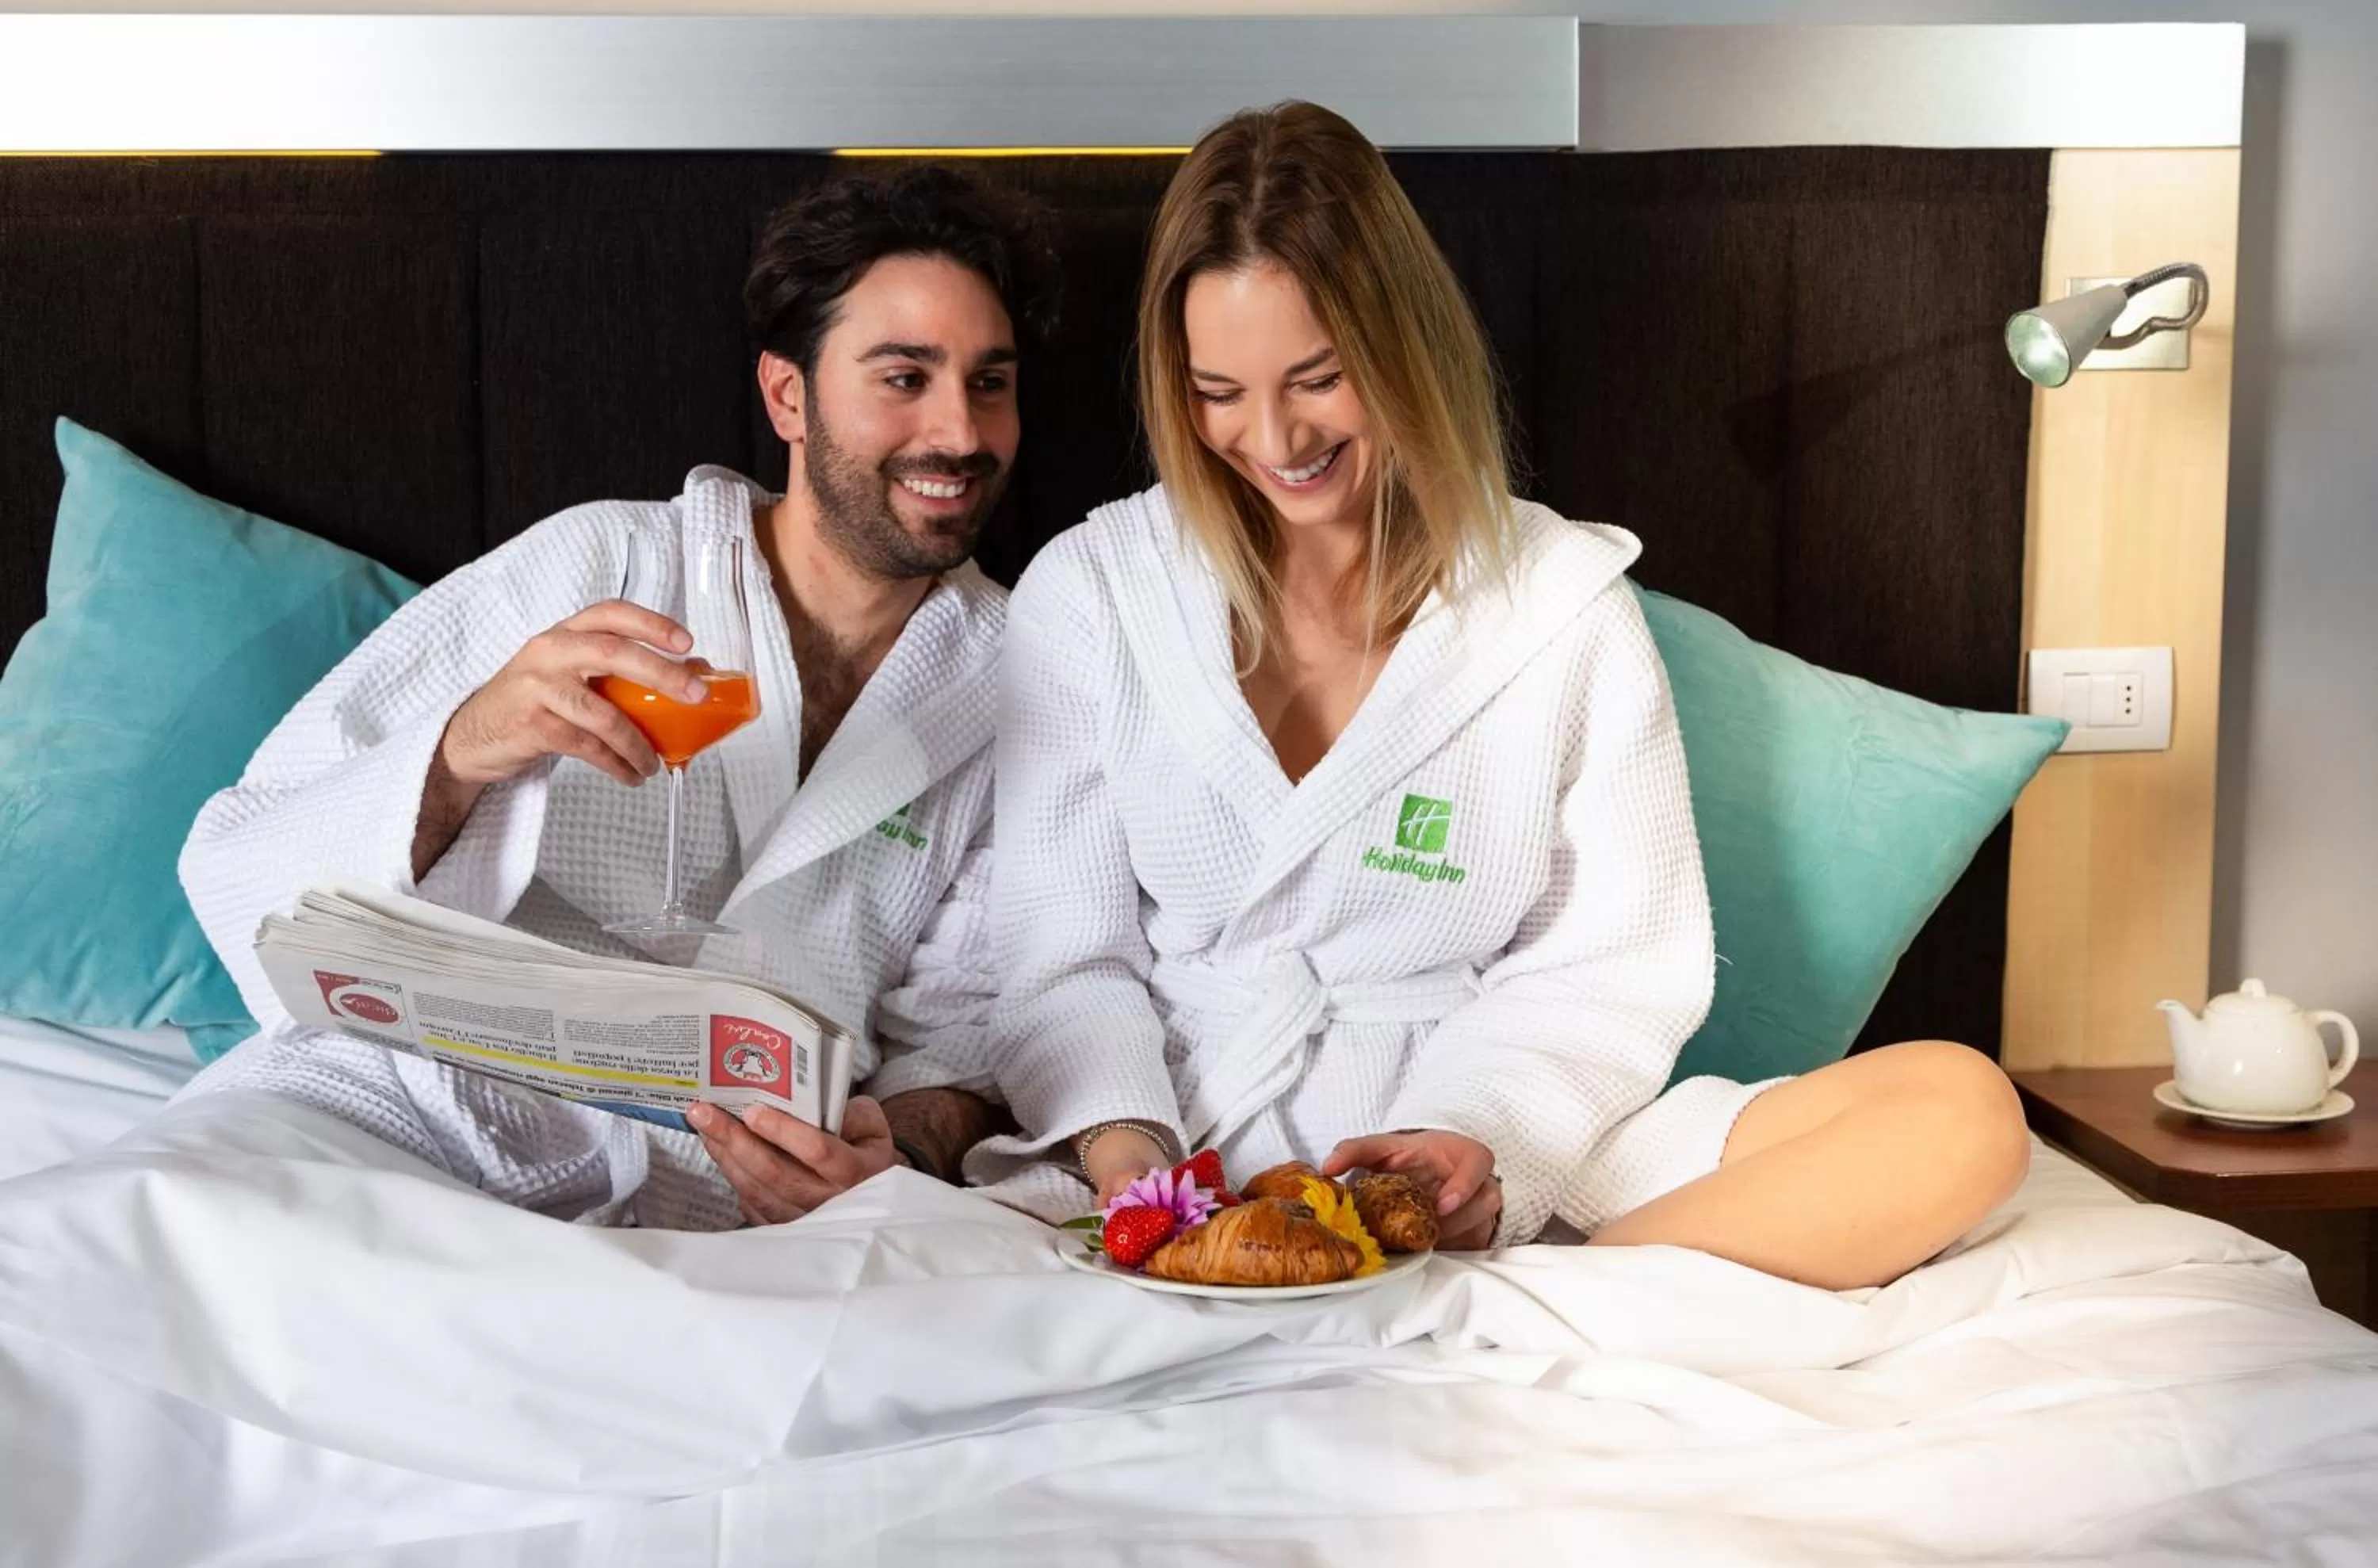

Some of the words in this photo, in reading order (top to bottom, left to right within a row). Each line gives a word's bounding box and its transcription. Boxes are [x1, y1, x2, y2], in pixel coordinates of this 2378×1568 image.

[1361, 846, 1438, 883] Holiday
[1436, 858, 1466, 884] Inn
[680, 1058, 700, 1069] per
